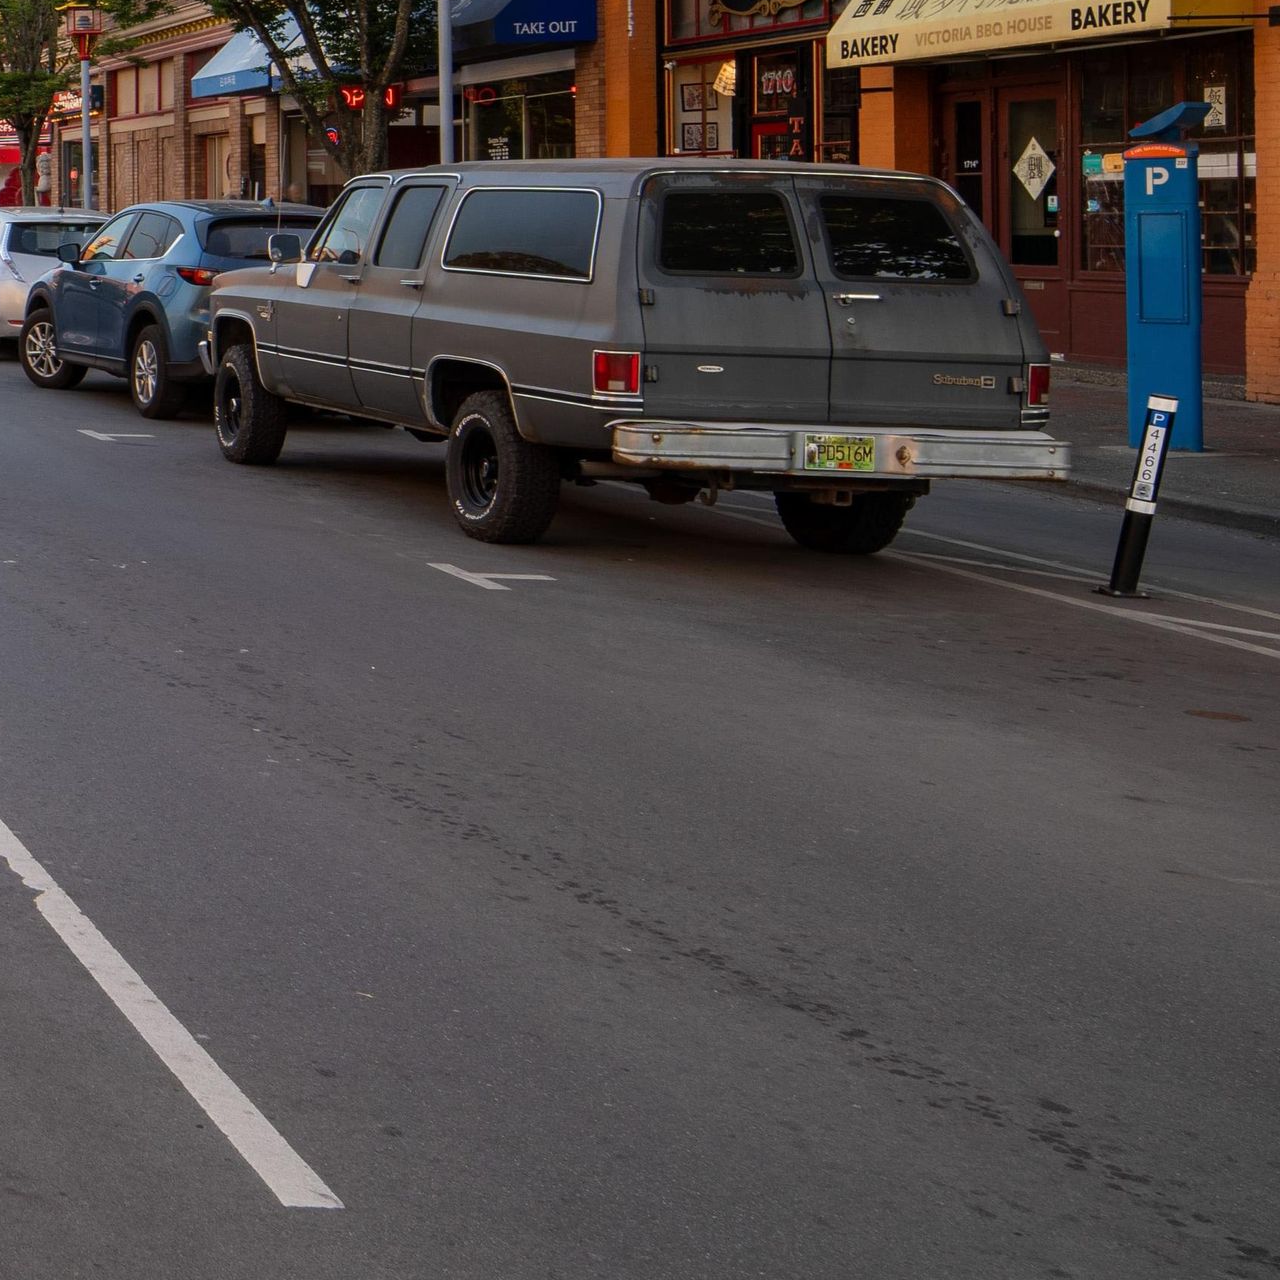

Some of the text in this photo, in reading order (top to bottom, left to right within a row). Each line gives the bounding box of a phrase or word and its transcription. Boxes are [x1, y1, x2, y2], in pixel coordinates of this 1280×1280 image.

[513, 21, 578, 35] TAKE OUT
[841, 0, 1150, 59] BAKERY VICTORIA BBQ HOUSE BAKERY
[762, 69, 794, 95] 1710
[1146, 167, 1170, 196] P
[933, 374, 981, 386] Suburban
[1152, 413, 1165, 426] P
[817, 444, 872, 462] PD516M
